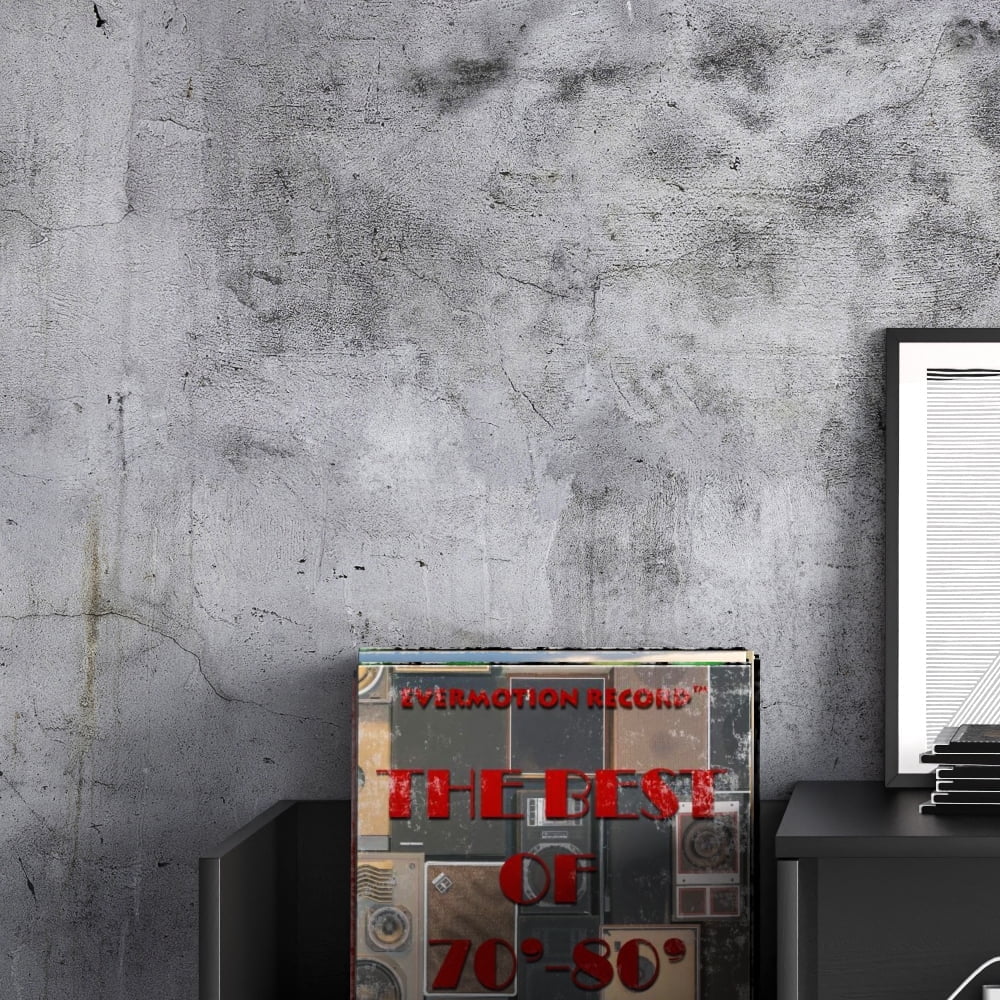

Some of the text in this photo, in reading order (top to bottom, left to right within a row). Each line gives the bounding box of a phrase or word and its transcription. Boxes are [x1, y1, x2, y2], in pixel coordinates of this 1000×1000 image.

[401, 687, 579, 709] EVERMOTION
[377, 769, 728, 819] THE BEST
[499, 853, 597, 905] OF
